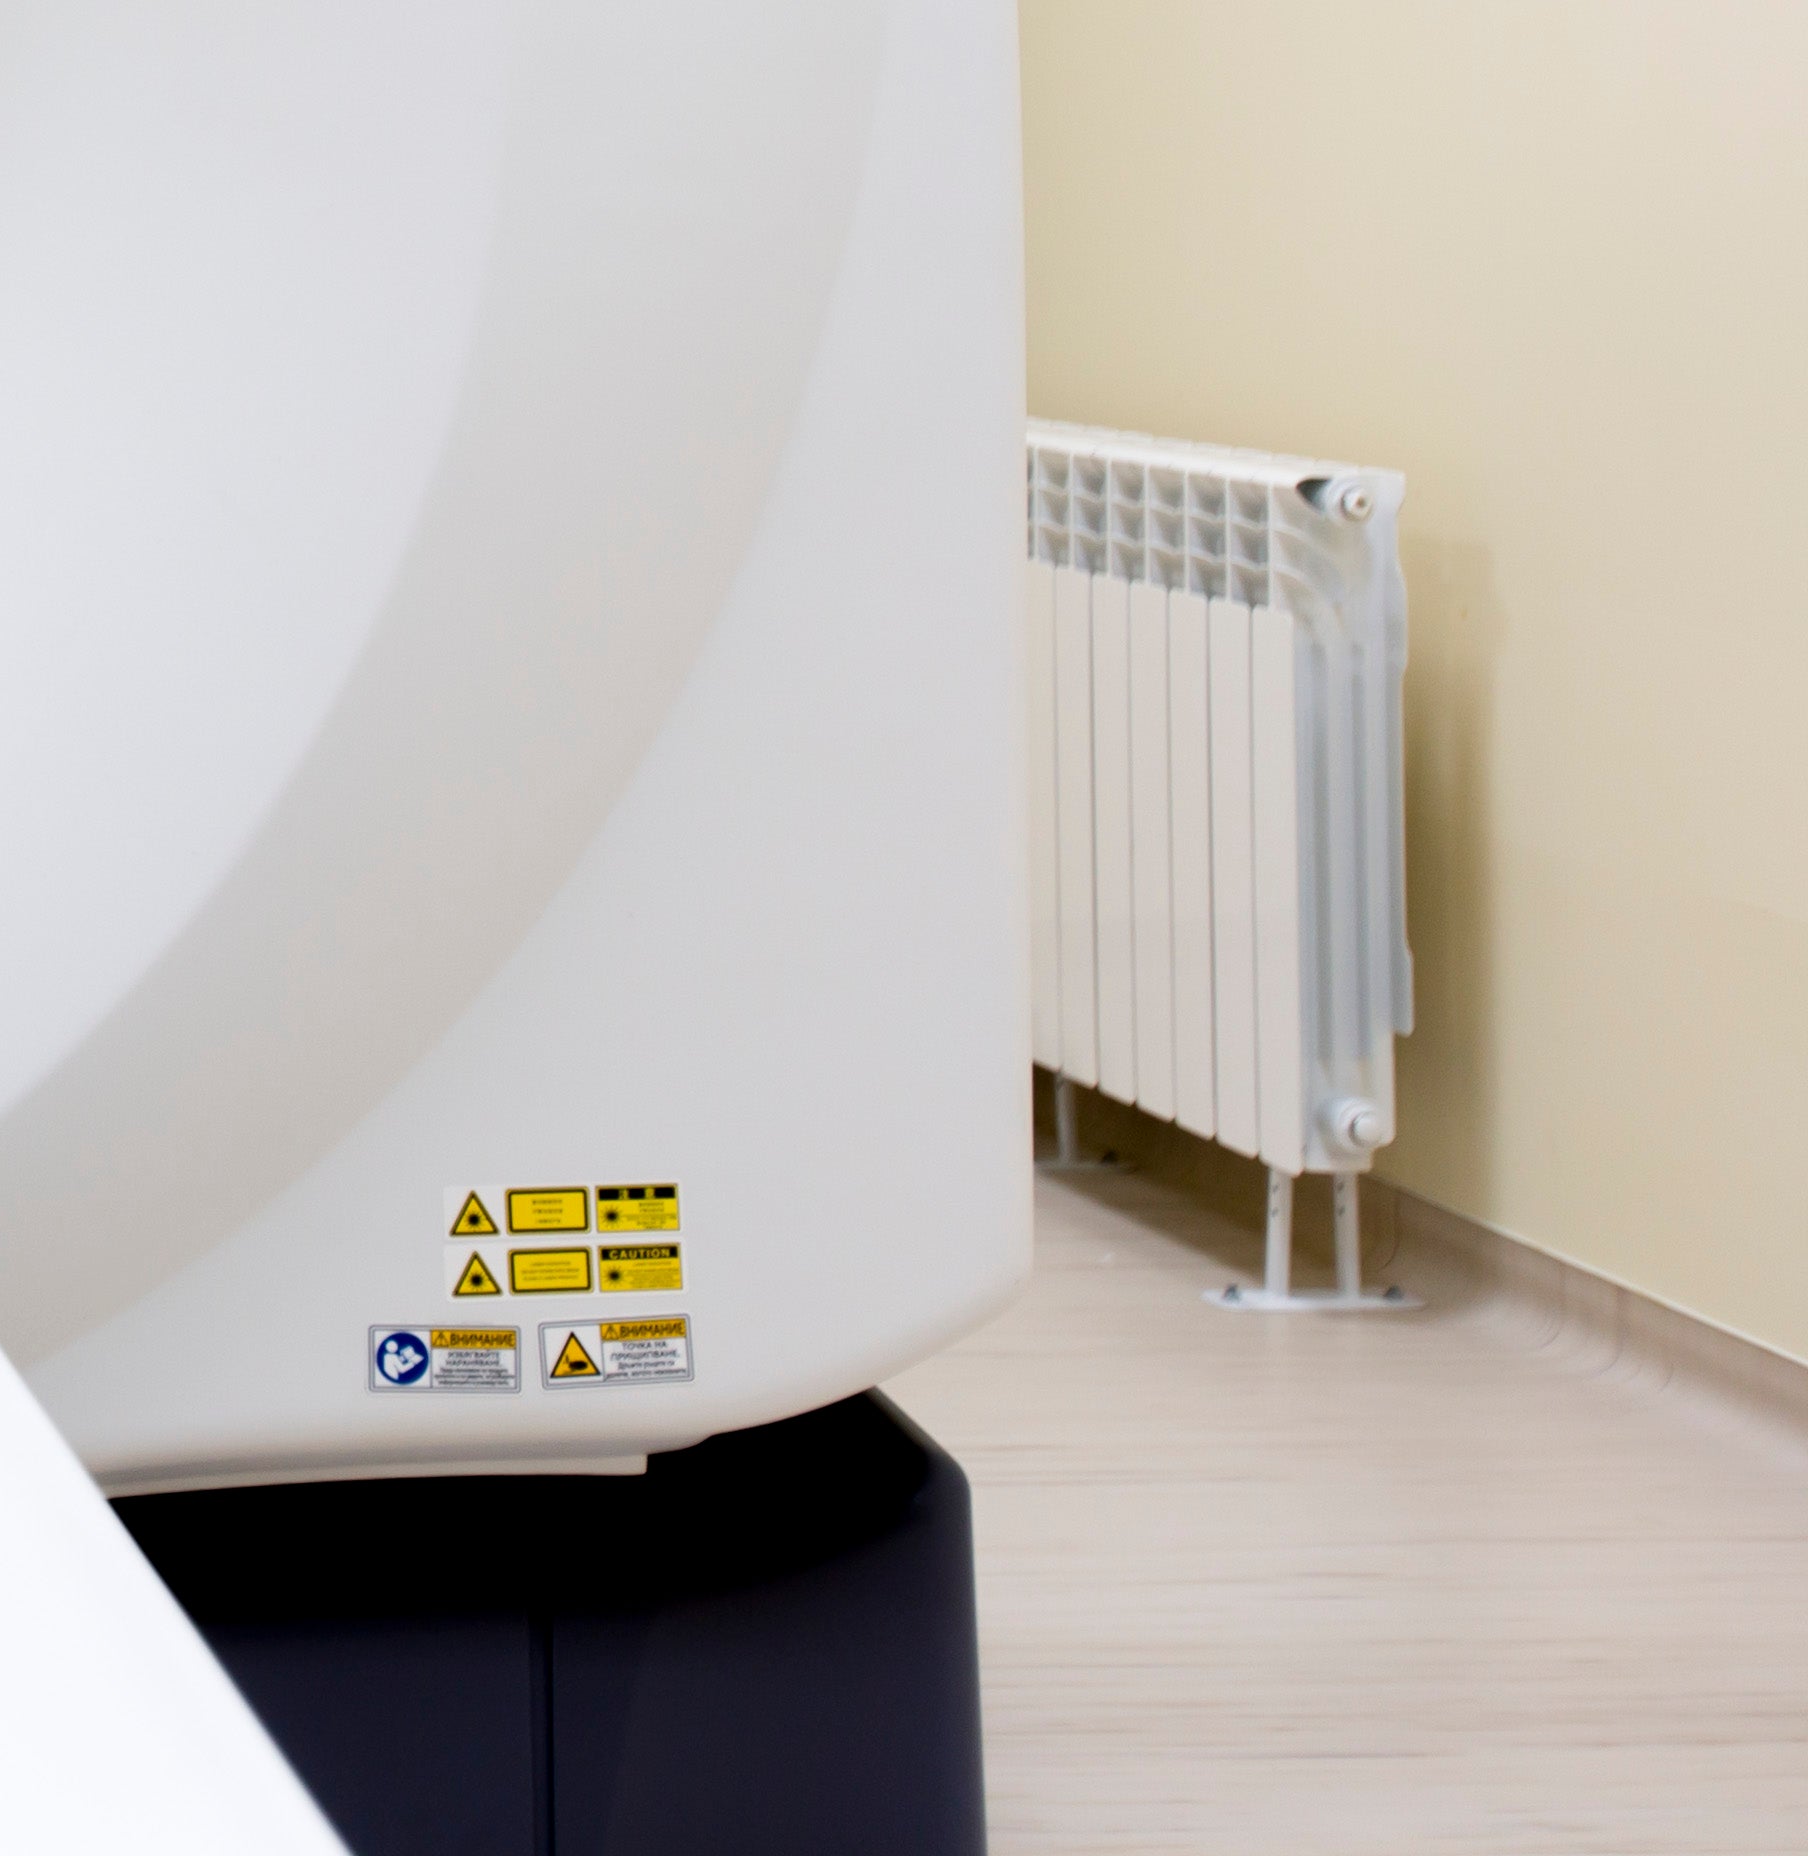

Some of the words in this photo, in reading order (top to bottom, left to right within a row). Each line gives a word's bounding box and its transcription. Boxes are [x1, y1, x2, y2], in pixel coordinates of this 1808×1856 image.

[609, 1248, 670, 1260] CAUTION
[619, 1321, 684, 1338] ВНИМАНИЕ
[450, 1332, 514, 1347] ВНИМАНИЕ
